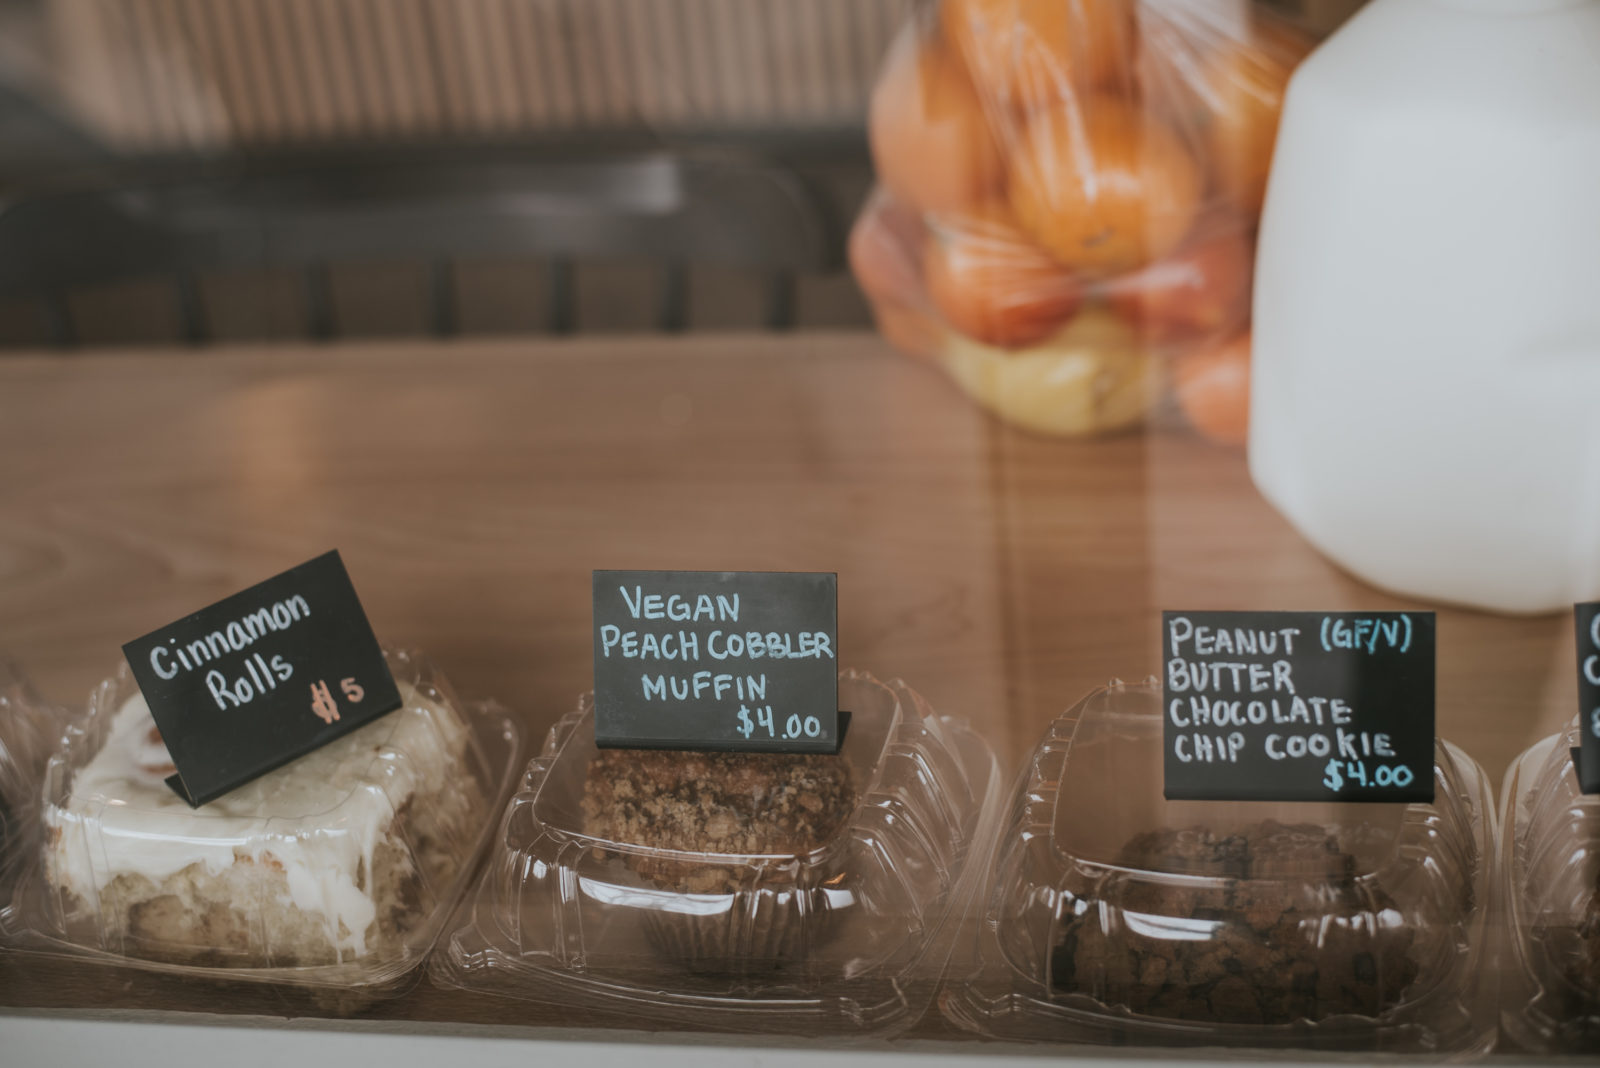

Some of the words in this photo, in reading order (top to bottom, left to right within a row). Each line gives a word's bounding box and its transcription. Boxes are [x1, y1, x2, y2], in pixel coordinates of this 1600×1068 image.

[619, 585, 740, 622] VEGAN
[150, 594, 311, 680] Cinnamon
[600, 624, 699, 661] PEACH
[707, 630, 835, 660] COBBLER
[1169, 617, 1300, 656] PEANUT
[205, 653, 294, 711] Rolls
[641, 671, 766, 701] MUFFIN
[1168, 658, 1296, 694] BUTTER
[736, 704, 821, 739] $4.00
[1170, 695, 1352, 727] CHOCOLATE
[1175, 732, 1245, 762] CHIP
[1265, 727, 1396, 760] COOKIE
[1323, 758, 1414, 791] $4.00
